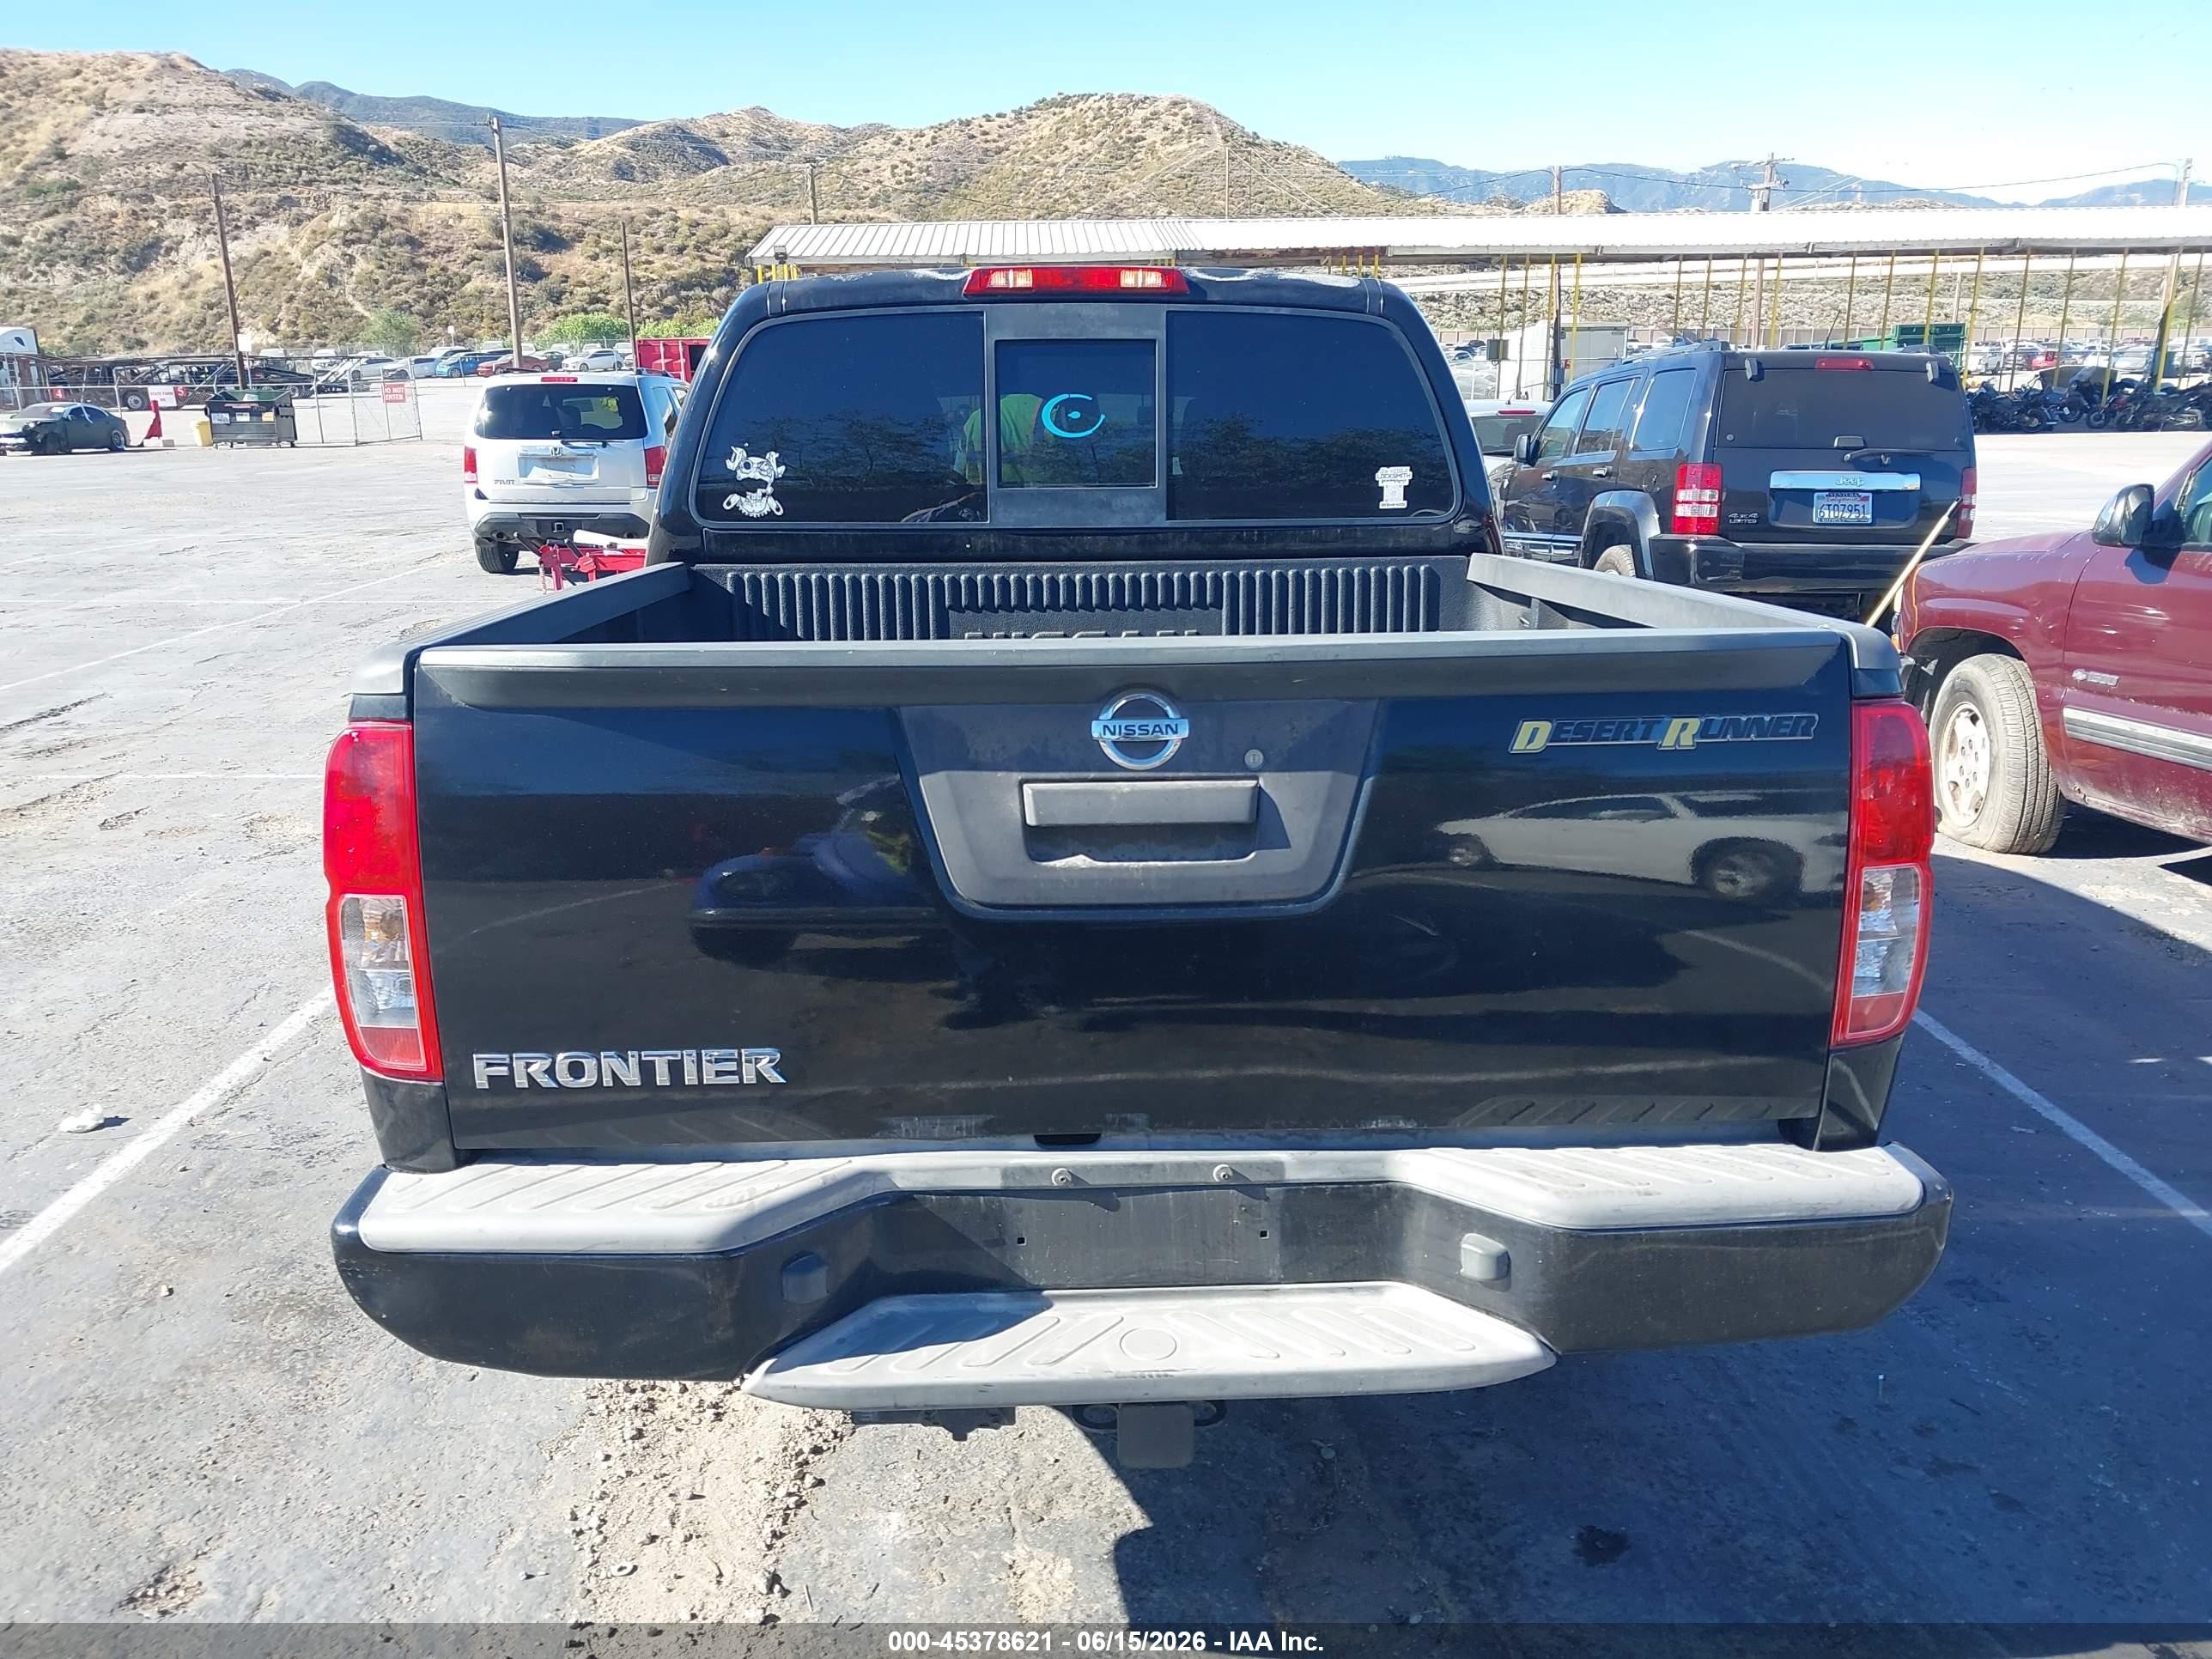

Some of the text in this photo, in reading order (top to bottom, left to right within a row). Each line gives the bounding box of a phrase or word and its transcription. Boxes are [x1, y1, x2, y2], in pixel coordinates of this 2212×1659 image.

[1103, 723, 1178, 736] NISSAN
[1509, 714, 1819, 753] DESERT RUNNER
[472, 1048, 787, 1089] FRONTIER
